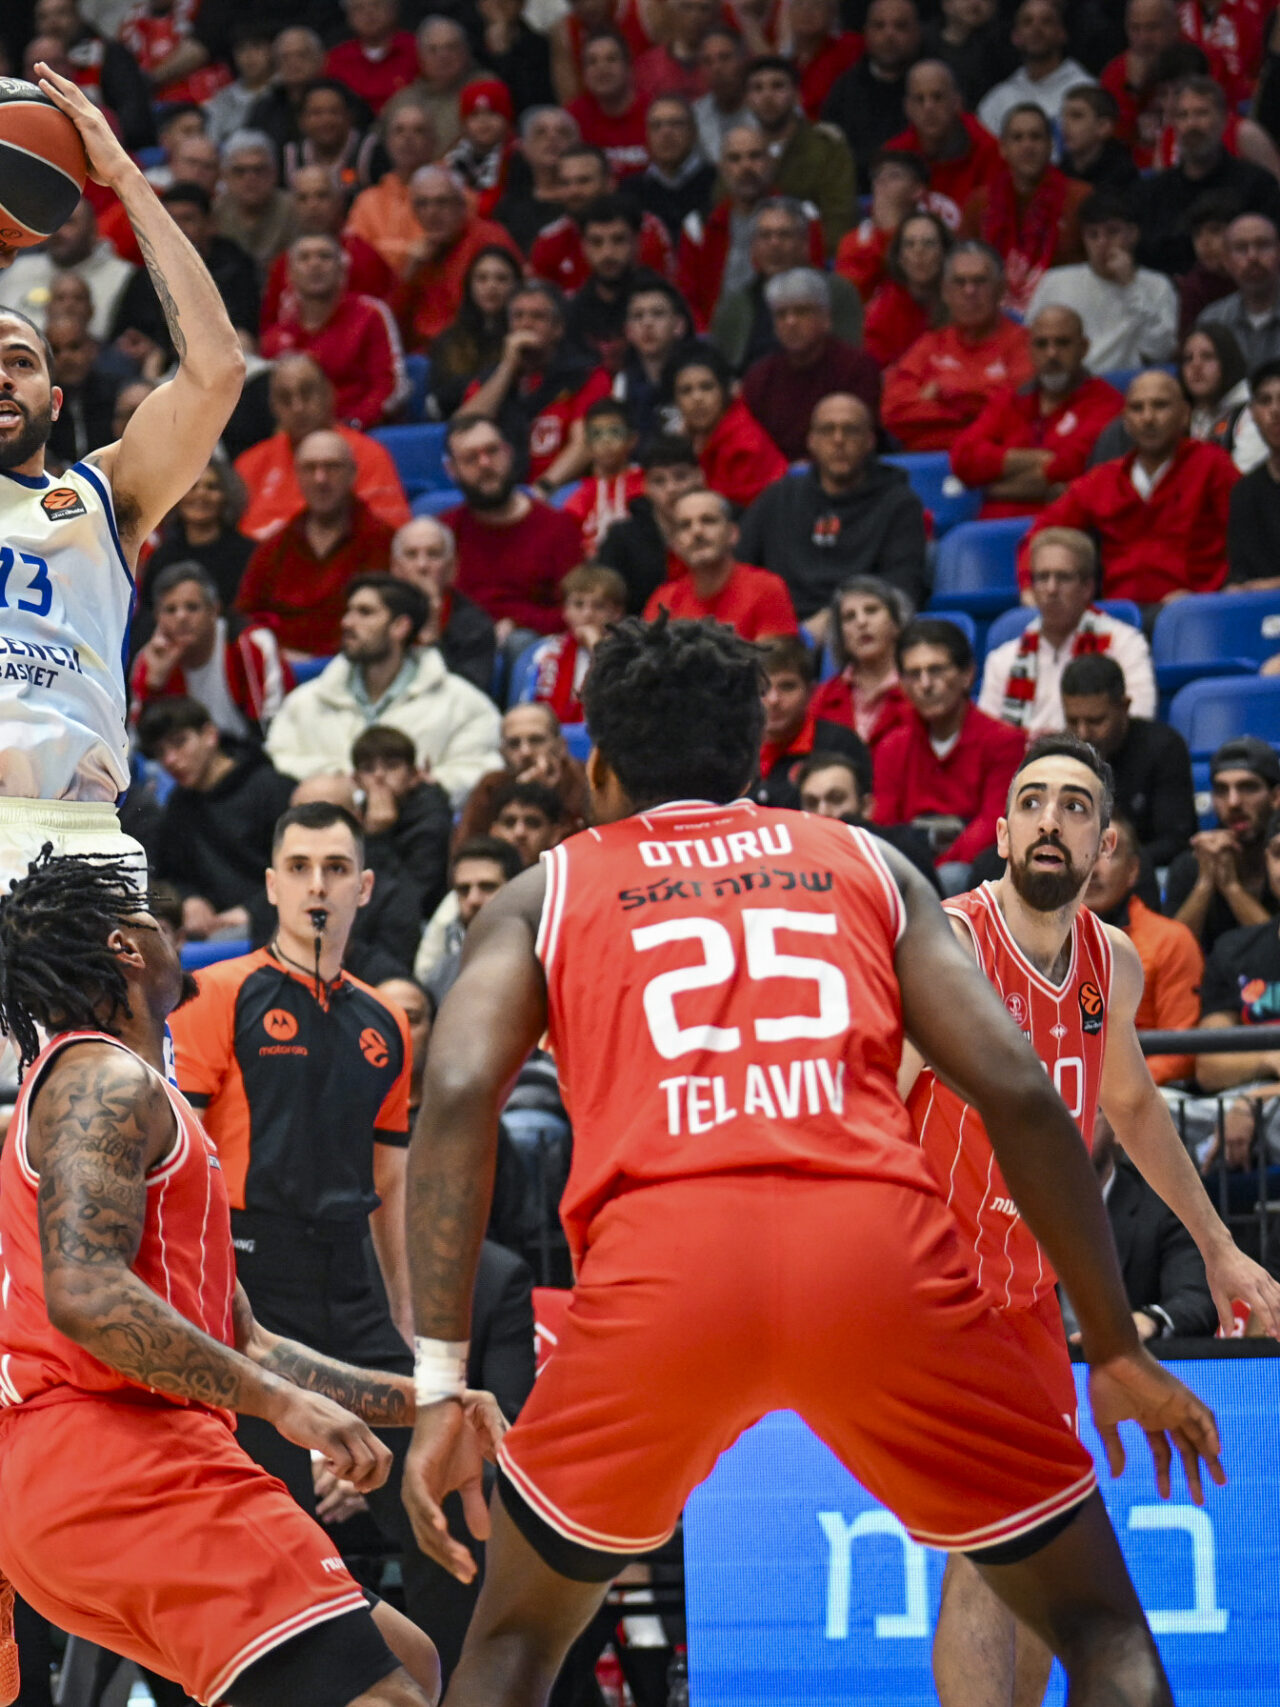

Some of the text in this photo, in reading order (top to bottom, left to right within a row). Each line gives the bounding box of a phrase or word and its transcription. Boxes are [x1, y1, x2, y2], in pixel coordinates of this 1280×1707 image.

[638, 824, 793, 867] OTURU
[631, 908, 850, 1060] 25
[259, 1045, 308, 1056] motorola
[658, 1058, 845, 1136] TEL AVIV
[1040, 1056, 1083, 1118] 0
